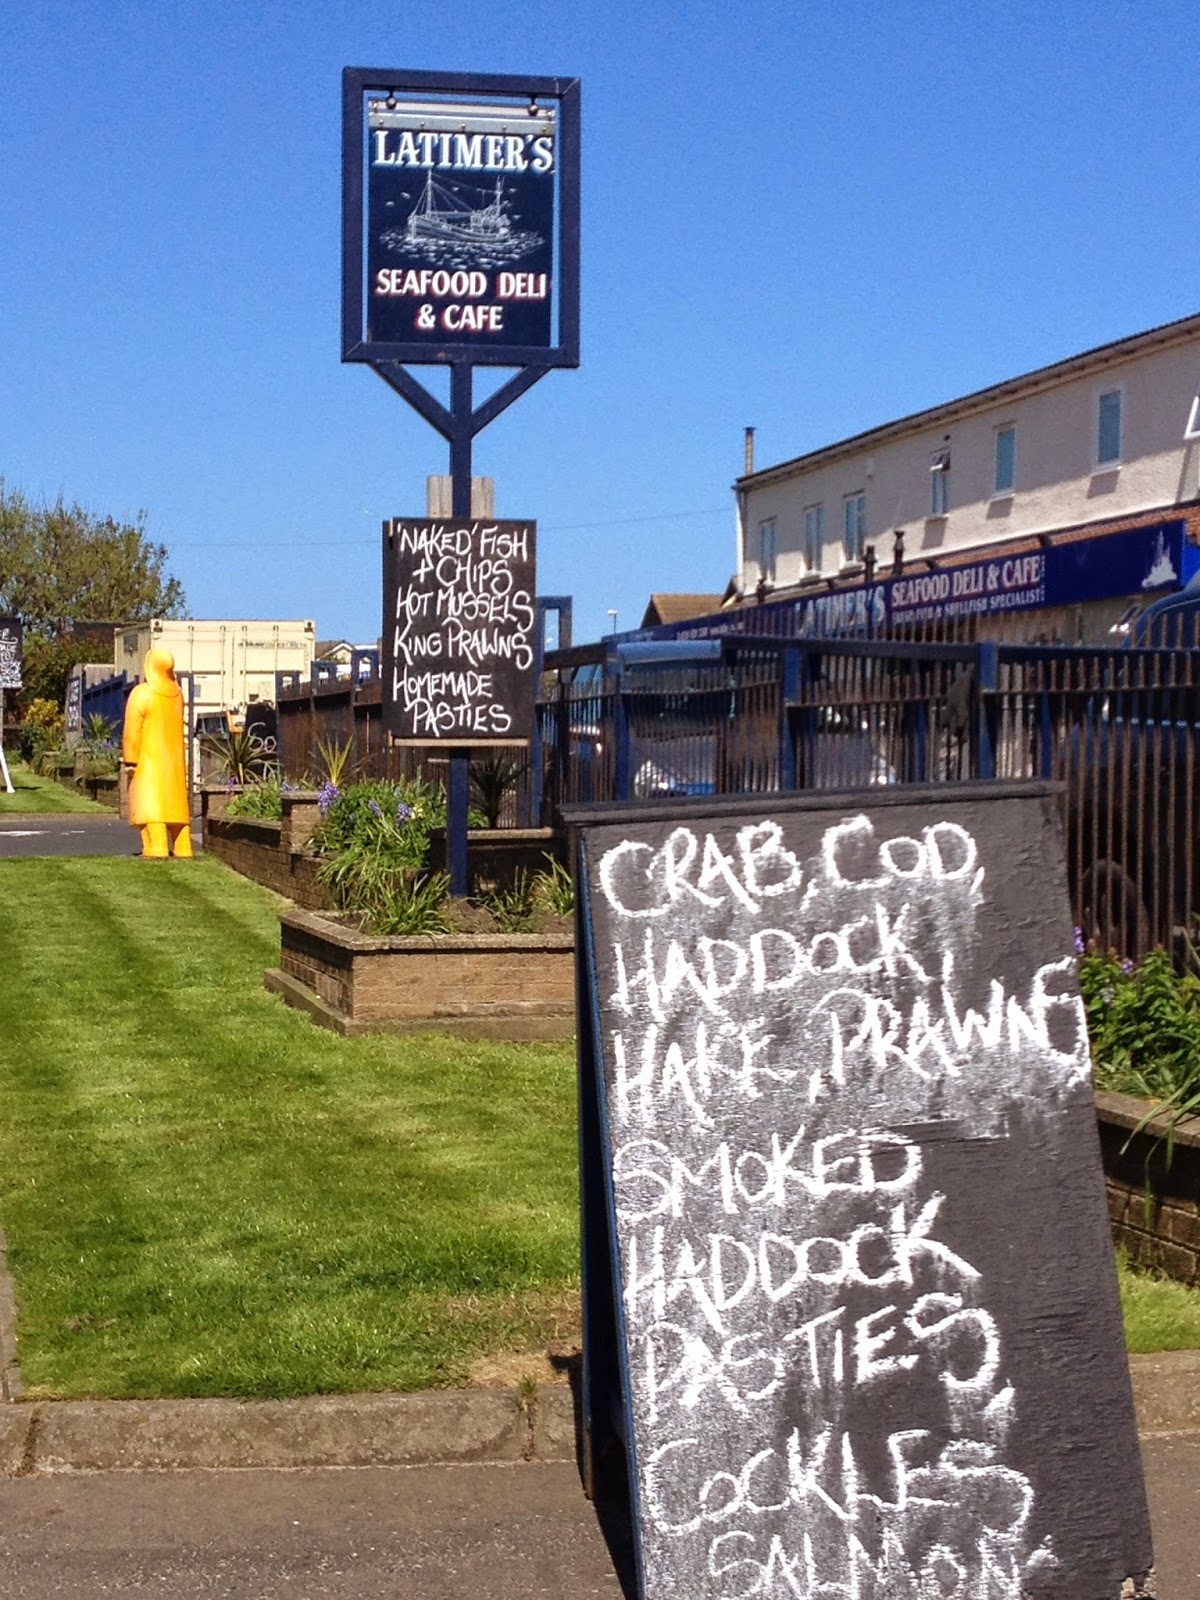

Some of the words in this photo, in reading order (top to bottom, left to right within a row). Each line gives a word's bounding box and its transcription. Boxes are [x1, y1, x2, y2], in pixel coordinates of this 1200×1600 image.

[374, 130, 552, 173] LATIMER'S
[376, 268, 487, 297] SEAFOOD
[497, 272, 546, 298] DELI
[416, 303, 436, 329] &
[443, 304, 503, 330] CAFE
[480, 525, 528, 561] FISH
[436, 554, 513, 596] CHIPS
[891, 573, 950, 607] SEAFOOD
[953, 566, 984, 597] DELI
[987, 563, 1000, 590] &
[1002, 554, 1041, 588] CAFE
[396, 584, 433, 620] HOT
[436, 586, 534, 633] MUSSELS
[393, 622, 442, 665] KING
[442, 617, 533, 669] PRAWNS
[393, 665, 492, 703] HOMEMADE
[404, 700, 511, 737] PASTIES
[610, 902, 934, 1022] HADDOCK
[612, 1126, 924, 1222] SMOKED
[623, 1190, 983, 1334] HADDOCK
[645, 1428, 1035, 1537] COCKLES
